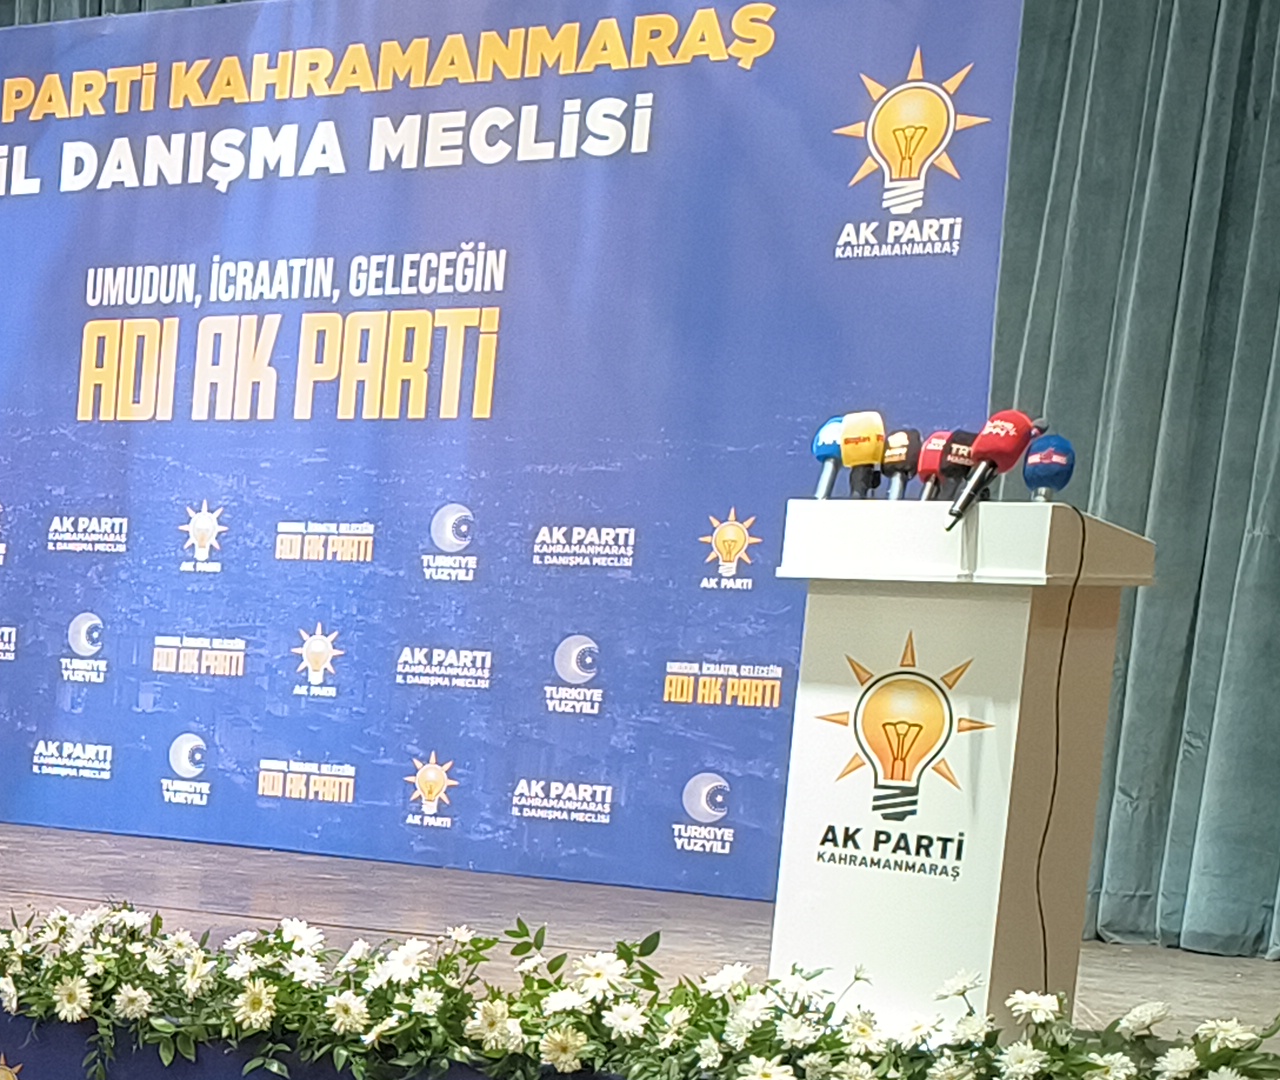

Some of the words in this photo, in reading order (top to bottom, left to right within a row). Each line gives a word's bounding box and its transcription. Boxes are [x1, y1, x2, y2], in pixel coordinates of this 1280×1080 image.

[169, 1, 778, 111] KAHRAMANMARAŞ
[60, 120, 347, 193] DANIŞMA
[368, 93, 654, 173] MECLİSİ
[837, 222, 879, 245] AK
[835, 241, 959, 258] KAHRAMANMARAŞ
[86, 263, 202, 308] UMUDUN,
[209, 254, 340, 304] İCRAATIN,
[349, 241, 507, 298] GELECEĞİN
[77, 317, 179, 421] ADI
[191, 313, 282, 420] AK
[48, 517, 76, 533] AK
[535, 526, 567, 544] AK
[700, 578, 718, 588] AK
[398, 647, 428, 665] AK
[664, 675, 695, 703] ADI
[697, 676, 723, 704] AK
[34, 740, 61, 757] AK
[514, 779, 545, 797] AK
[819, 825, 863, 849] AK
[873, 830, 965, 861] PARTİ
[817, 851, 961, 881] KAHRAMANMARAŞ
